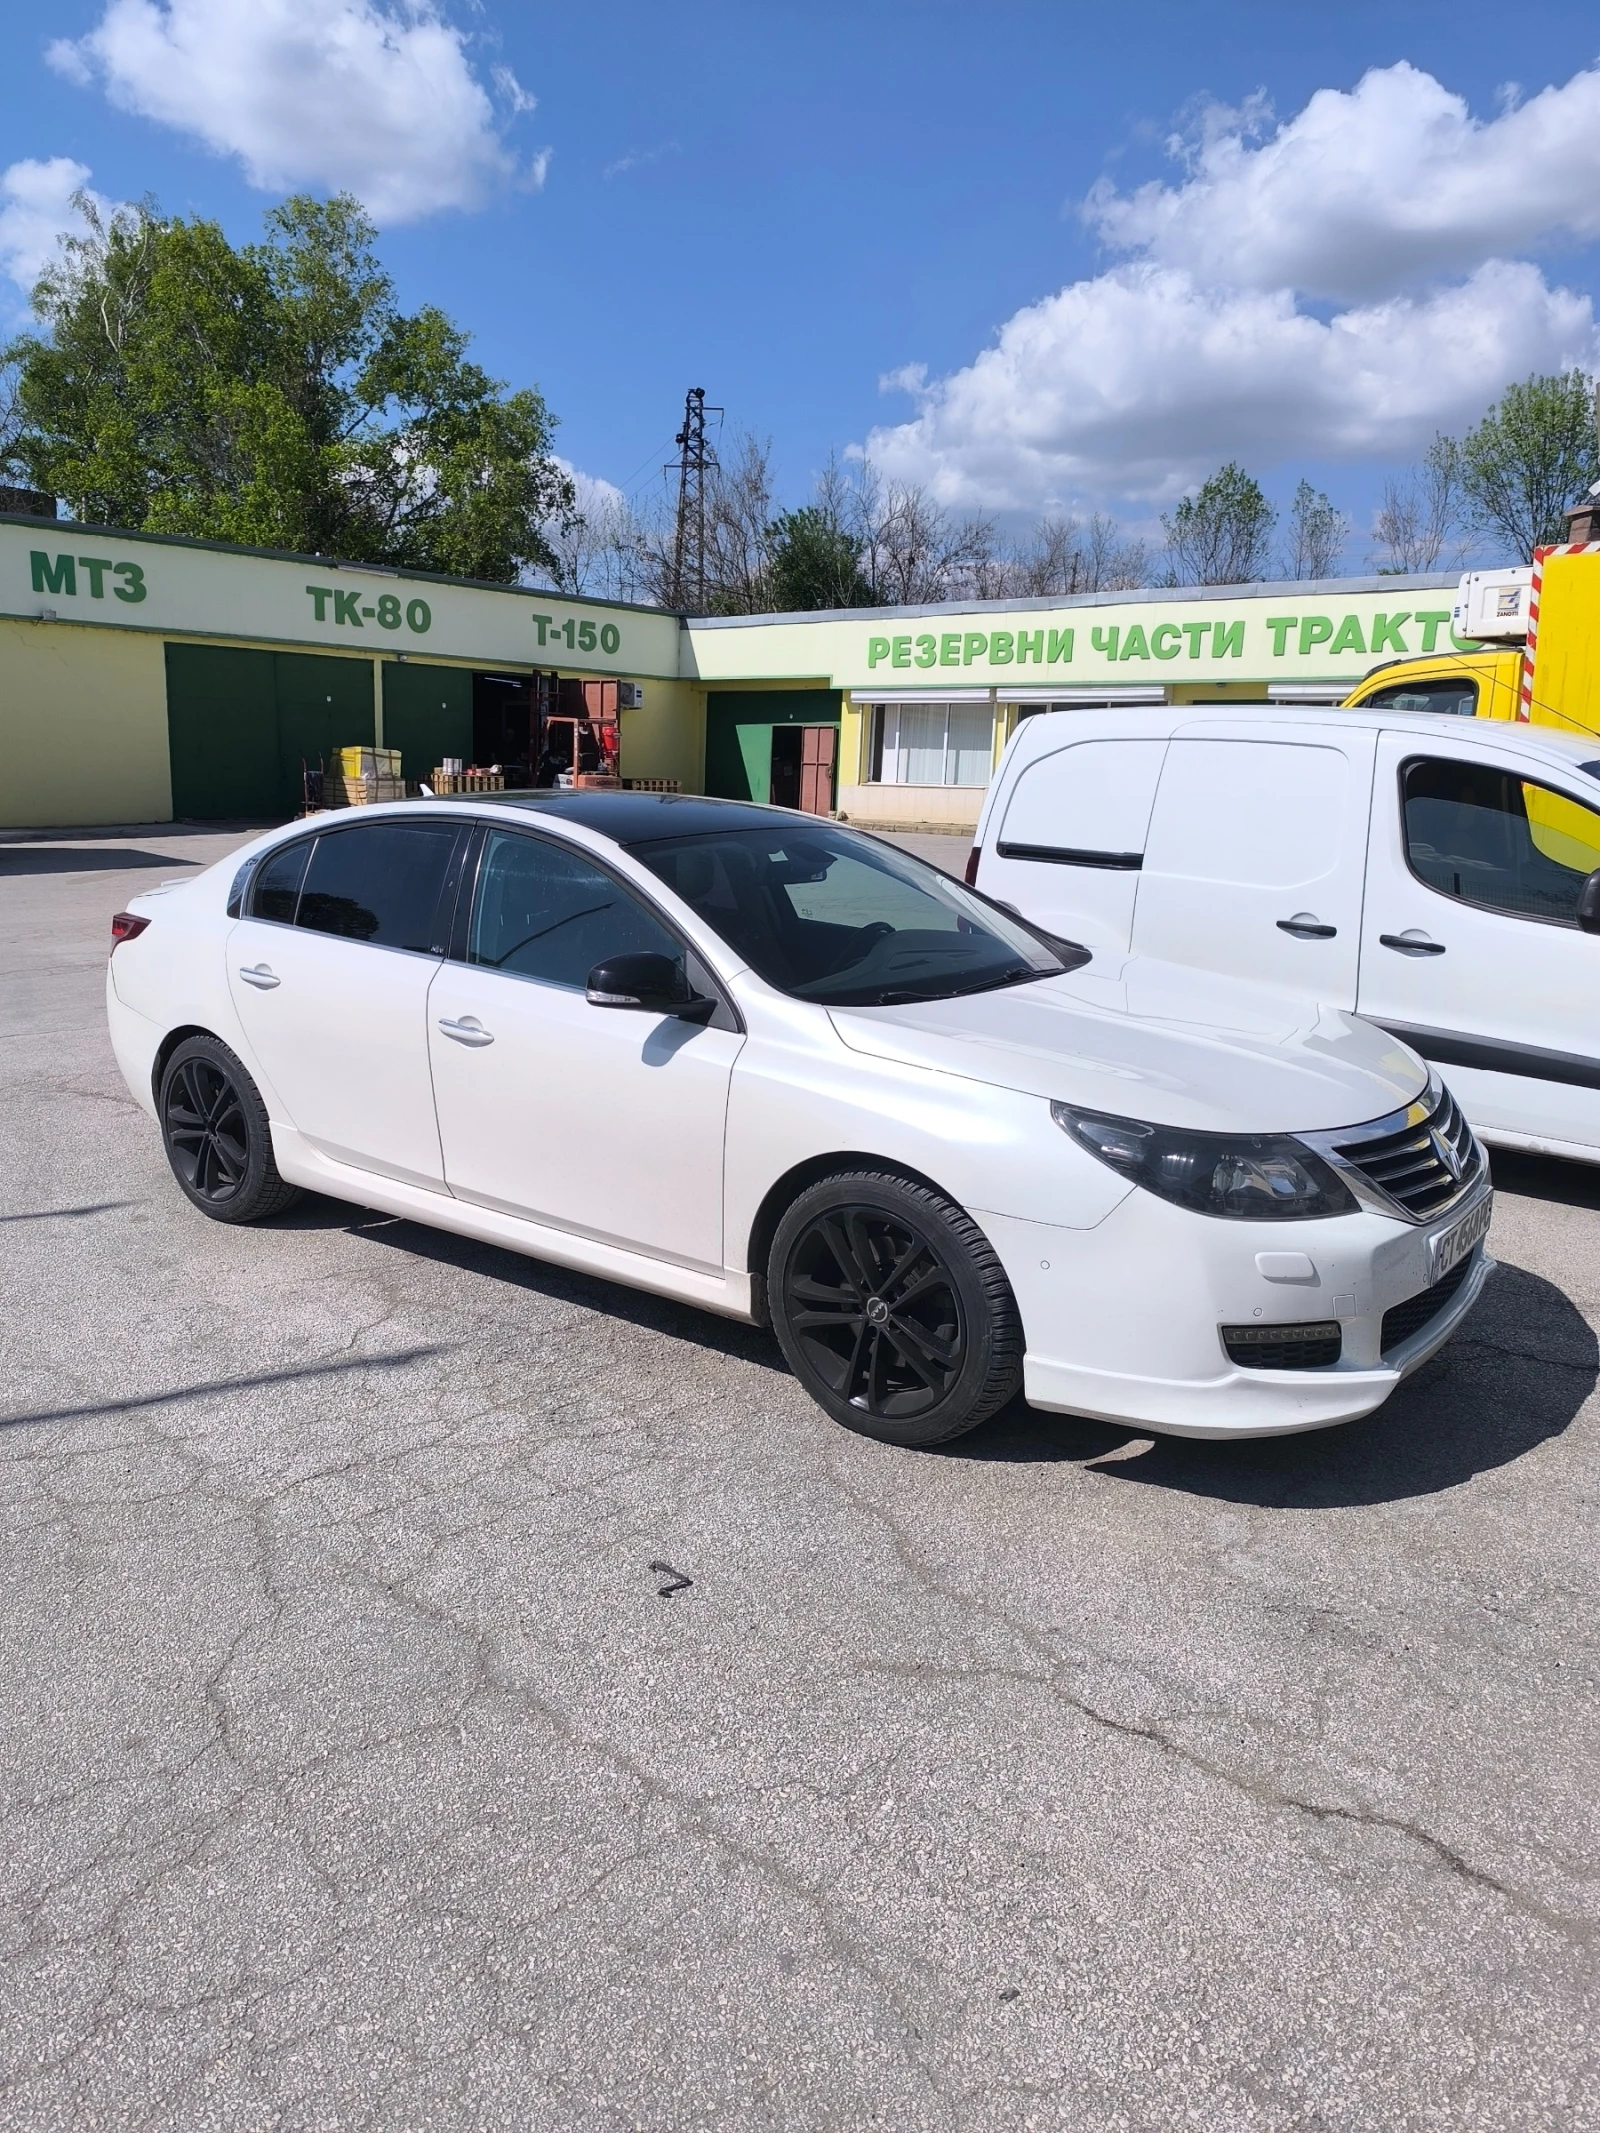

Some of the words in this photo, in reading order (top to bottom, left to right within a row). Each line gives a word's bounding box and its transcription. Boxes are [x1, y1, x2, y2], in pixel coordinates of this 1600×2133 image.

[30, 550, 147, 603] МТЗ
[306, 585, 432, 633] ТК-80
[532, 614, 621, 655] Т-150
[868, 629, 1074, 668] РЕЗЕРВНИ
[1091, 621, 1246, 661] ЧАСТИ
